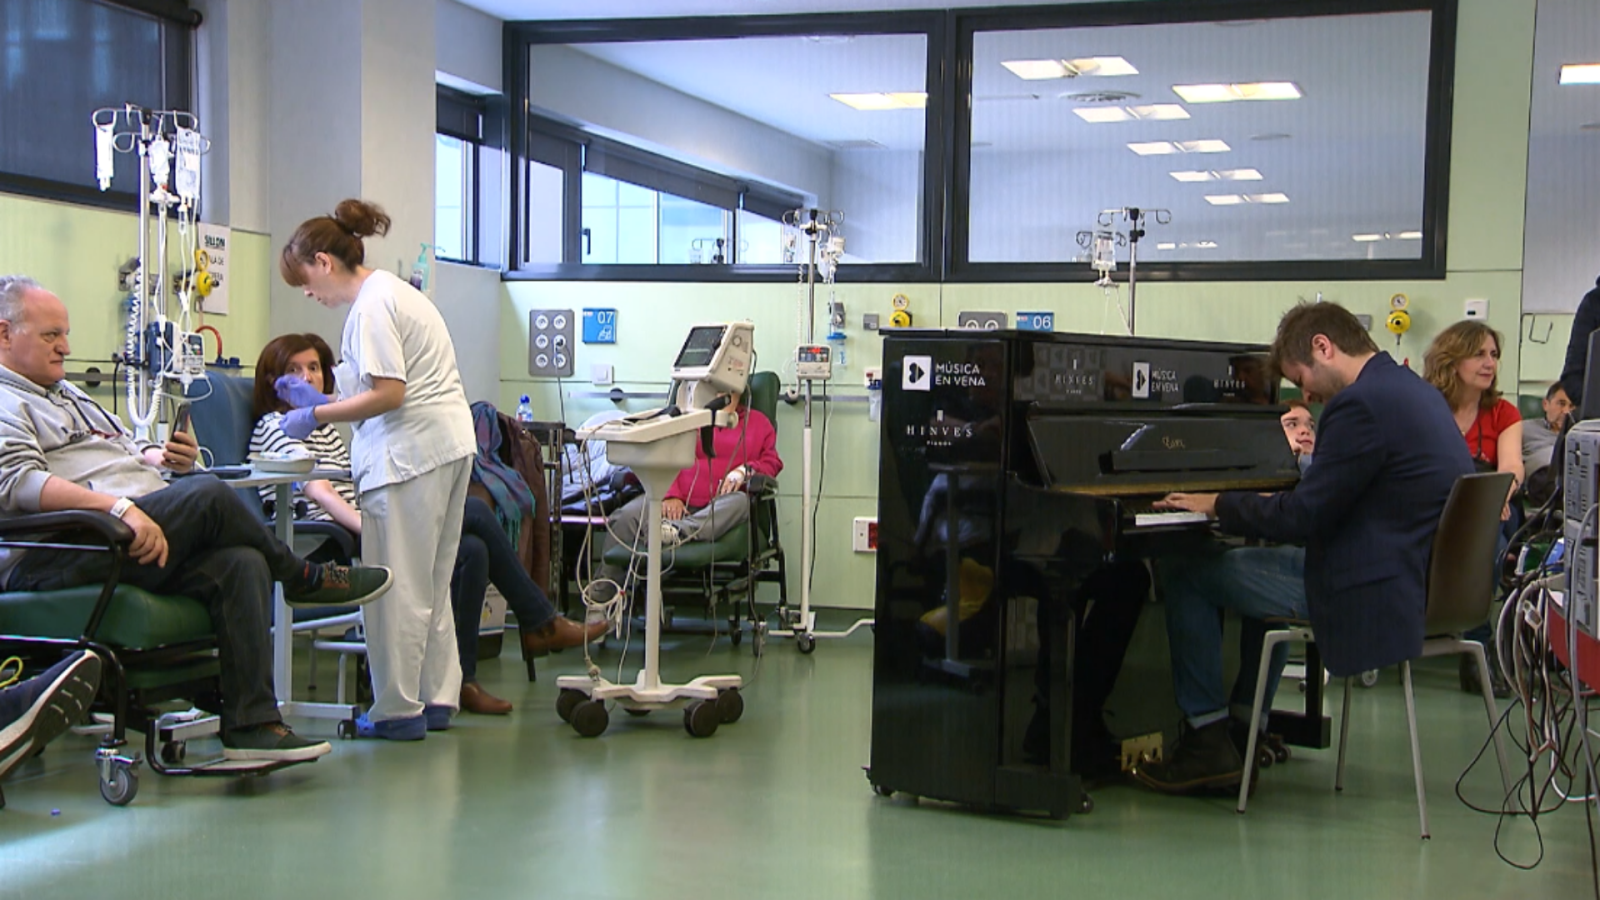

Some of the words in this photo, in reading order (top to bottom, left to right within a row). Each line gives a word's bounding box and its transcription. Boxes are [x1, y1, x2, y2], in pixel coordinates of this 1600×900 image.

[597, 311, 614, 324] 07
[1033, 315, 1051, 329] 06
[935, 361, 980, 375] MÚSICA
[935, 375, 951, 386] EN
[954, 376, 986, 387] VENA
[907, 425, 973, 438] HINVES
